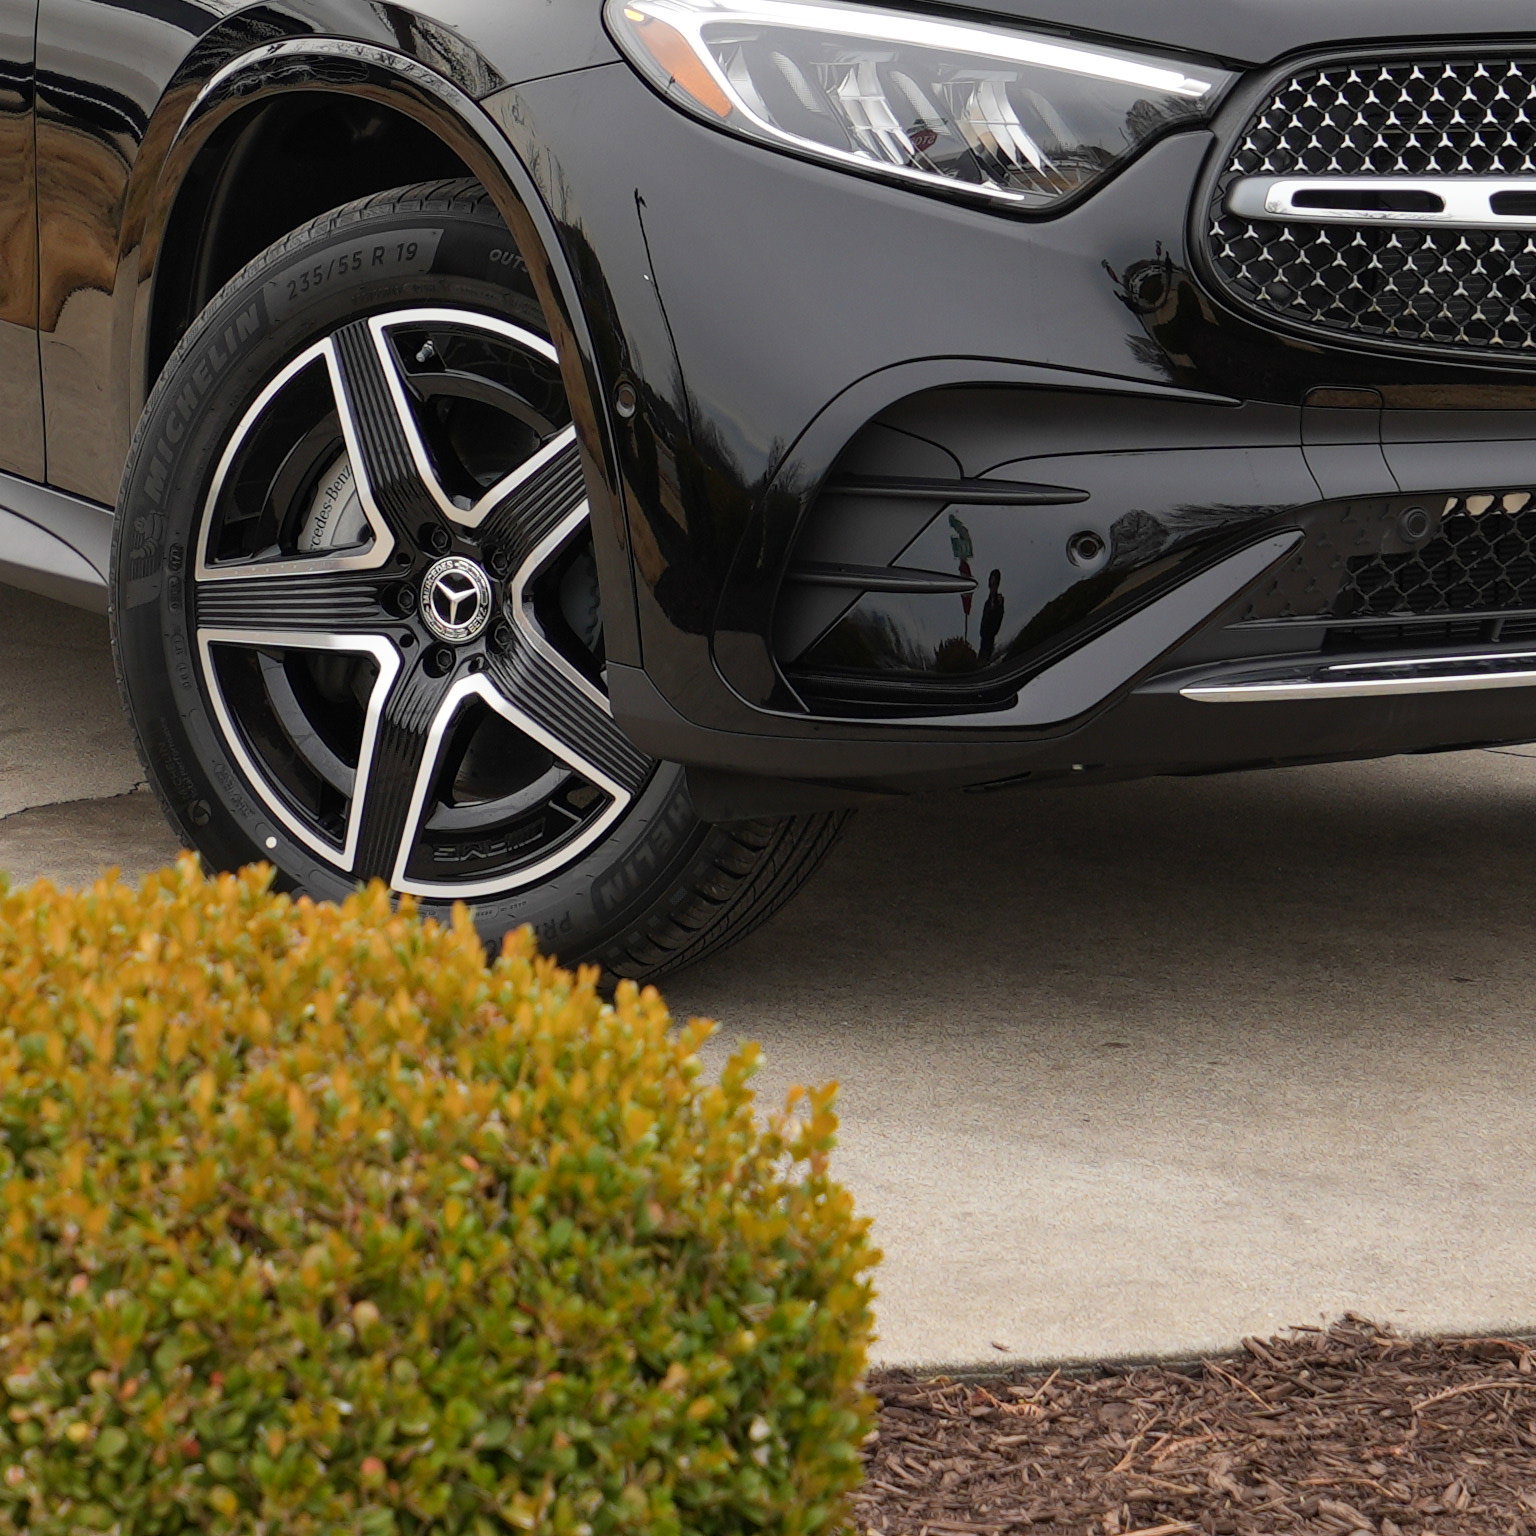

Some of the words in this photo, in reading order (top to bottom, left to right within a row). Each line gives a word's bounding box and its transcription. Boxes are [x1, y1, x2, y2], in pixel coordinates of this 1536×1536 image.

[286, 250, 363, 301] 235/55
[372, 245, 386, 267] R
[397, 242, 418, 262] 19
[143, 302, 262, 505] MICHELIN
[423, 560, 454, 604] MERCEDES
[468, 606, 488, 633] BENZ
[598, 791, 693, 913] HELIN
